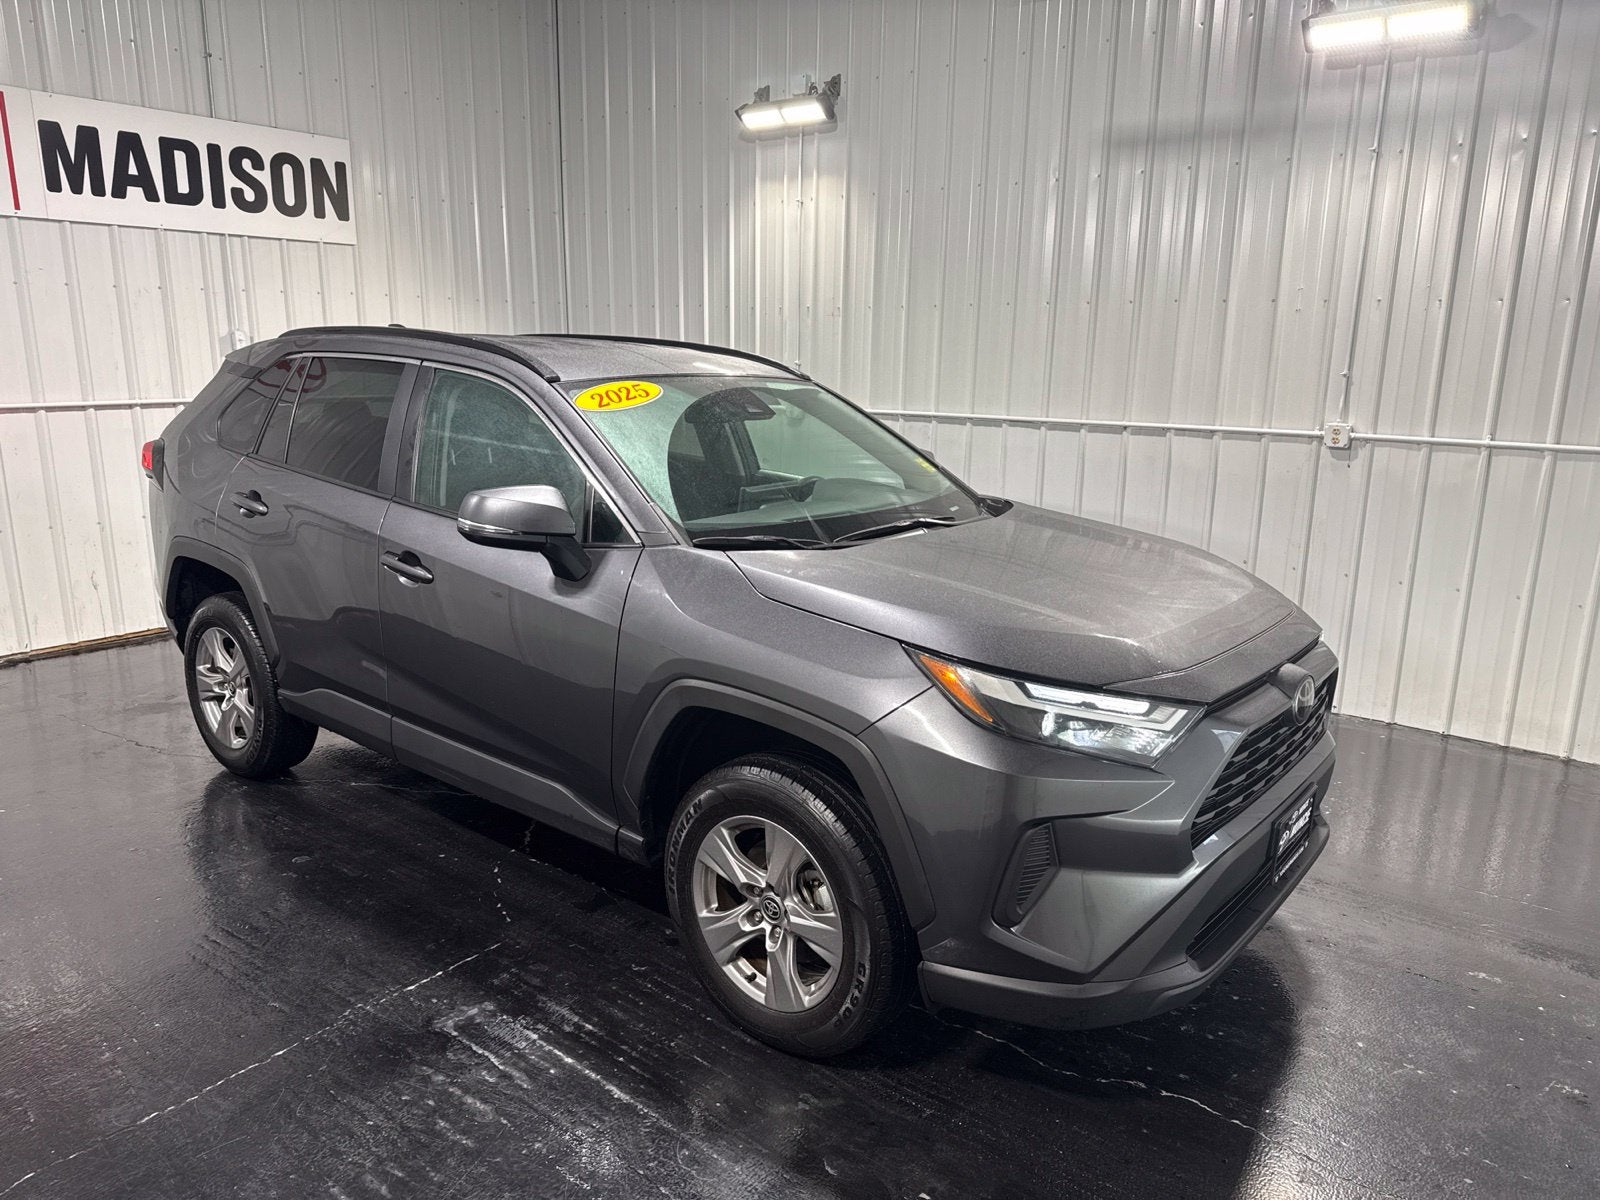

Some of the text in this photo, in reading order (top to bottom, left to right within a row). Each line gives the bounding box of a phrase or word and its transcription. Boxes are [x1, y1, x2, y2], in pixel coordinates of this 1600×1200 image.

[37, 119, 350, 222] MADISON
[590, 383, 650, 409] 2025
[667, 799, 703, 895] IRONMAN
